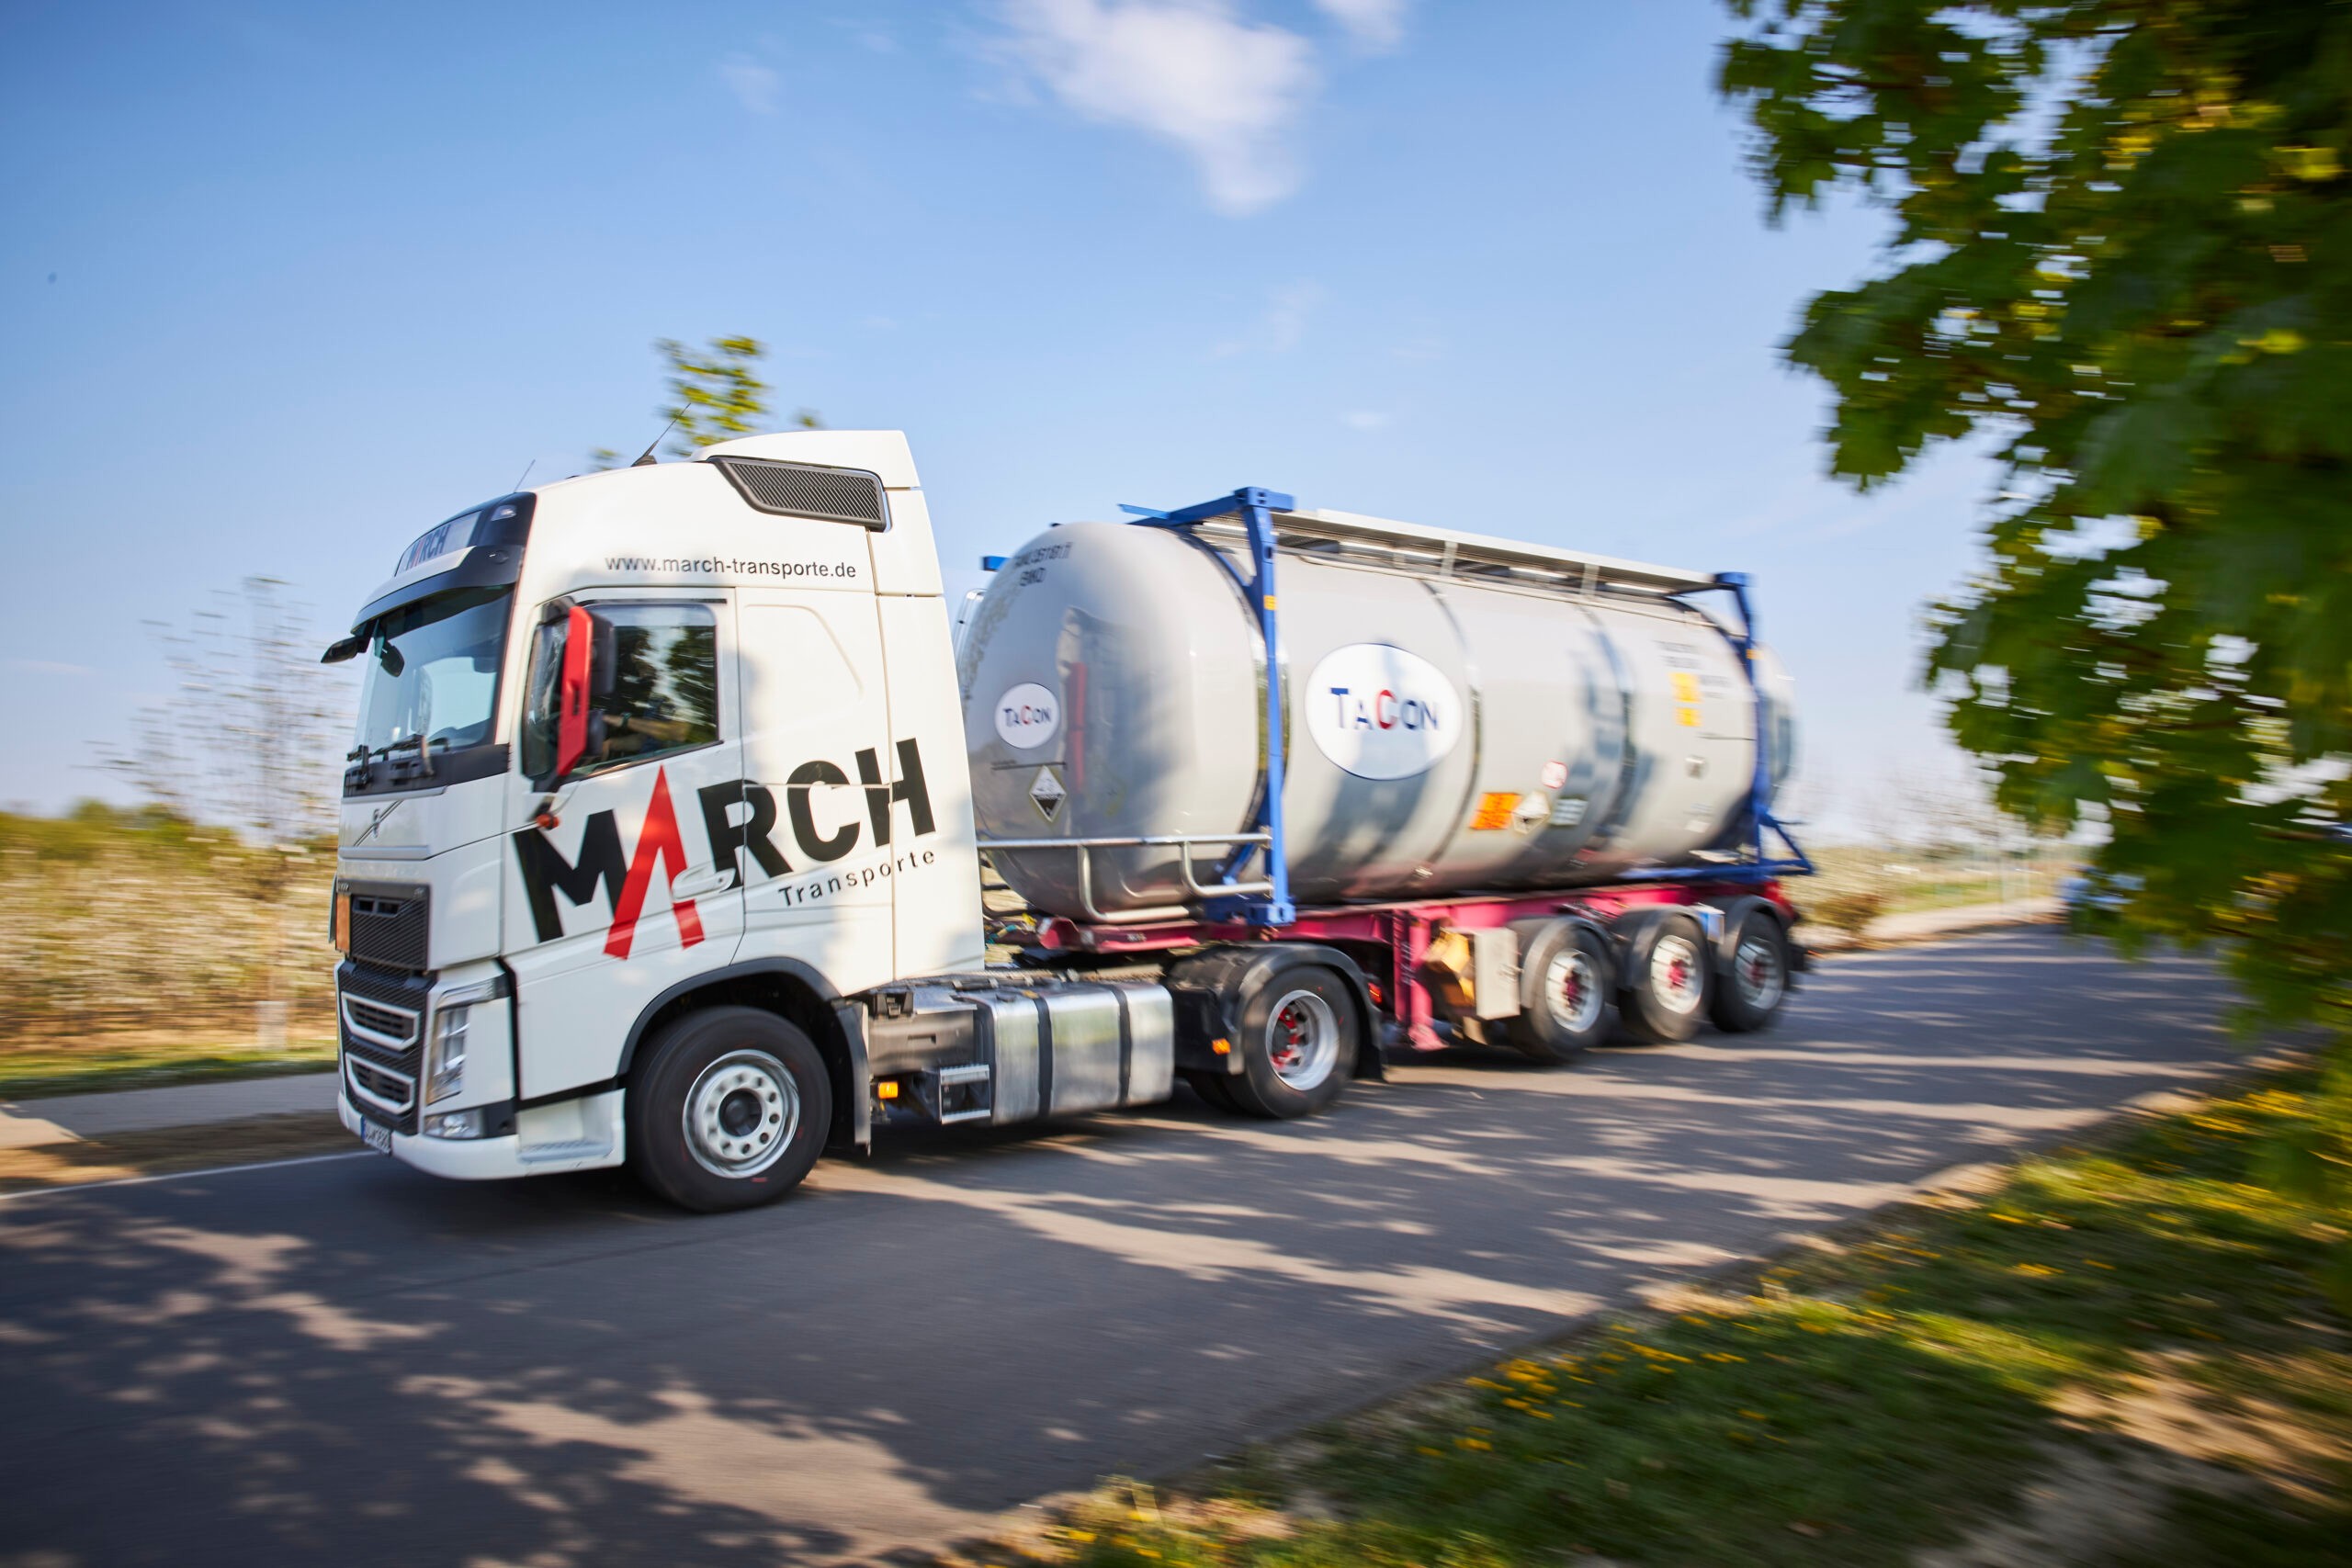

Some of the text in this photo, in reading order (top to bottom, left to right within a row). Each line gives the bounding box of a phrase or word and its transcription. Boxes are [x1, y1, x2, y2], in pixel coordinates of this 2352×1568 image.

[605, 556, 856, 580] www.march-transporte.de
[513, 737, 936, 961] MARCH
[778, 850, 935, 907] Transporte
